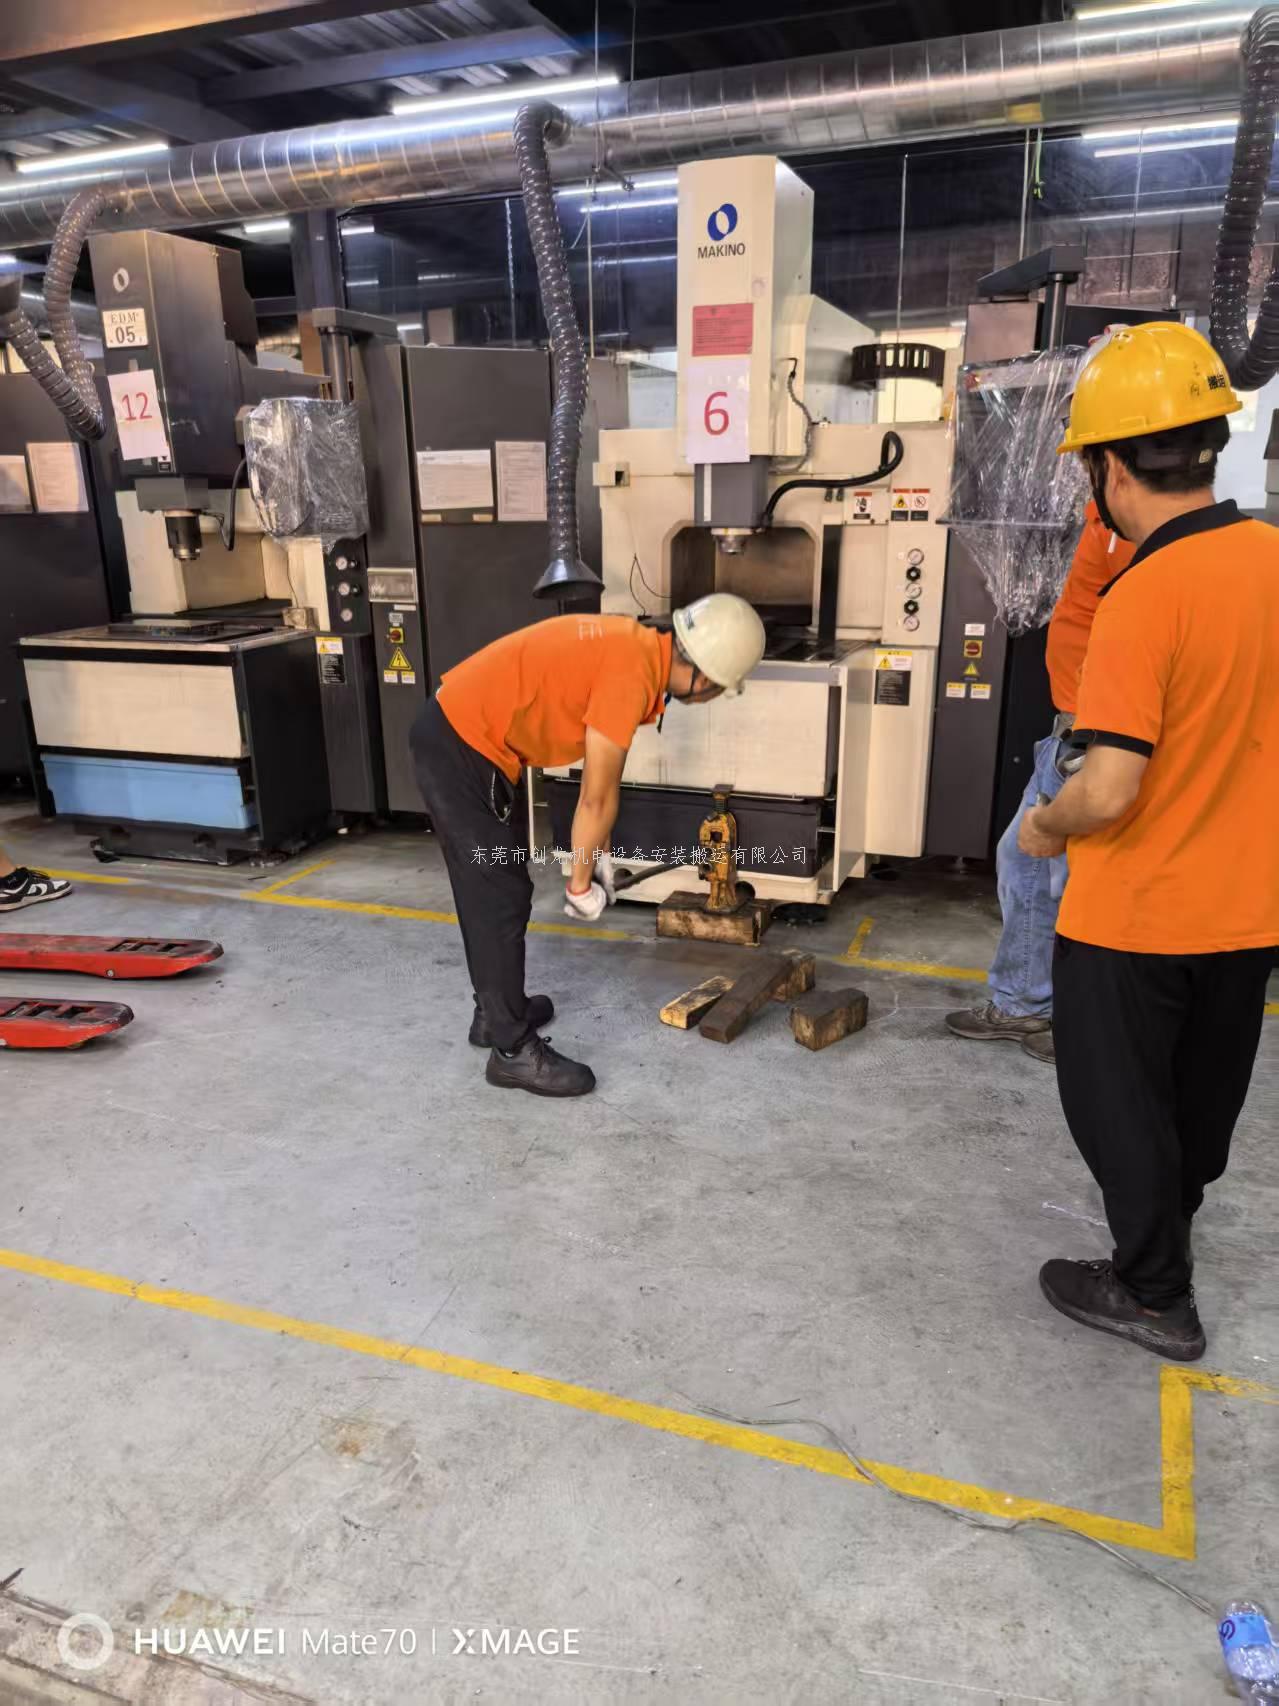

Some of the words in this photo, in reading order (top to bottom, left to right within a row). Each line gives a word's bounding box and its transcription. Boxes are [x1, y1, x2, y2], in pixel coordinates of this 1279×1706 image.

[697, 243, 746, 259] MAKINO
[111, 312, 137, 324] EDM
[115, 325, 136, 344] 05
[121, 391, 153, 421] 12
[703, 391, 730, 436] 6
